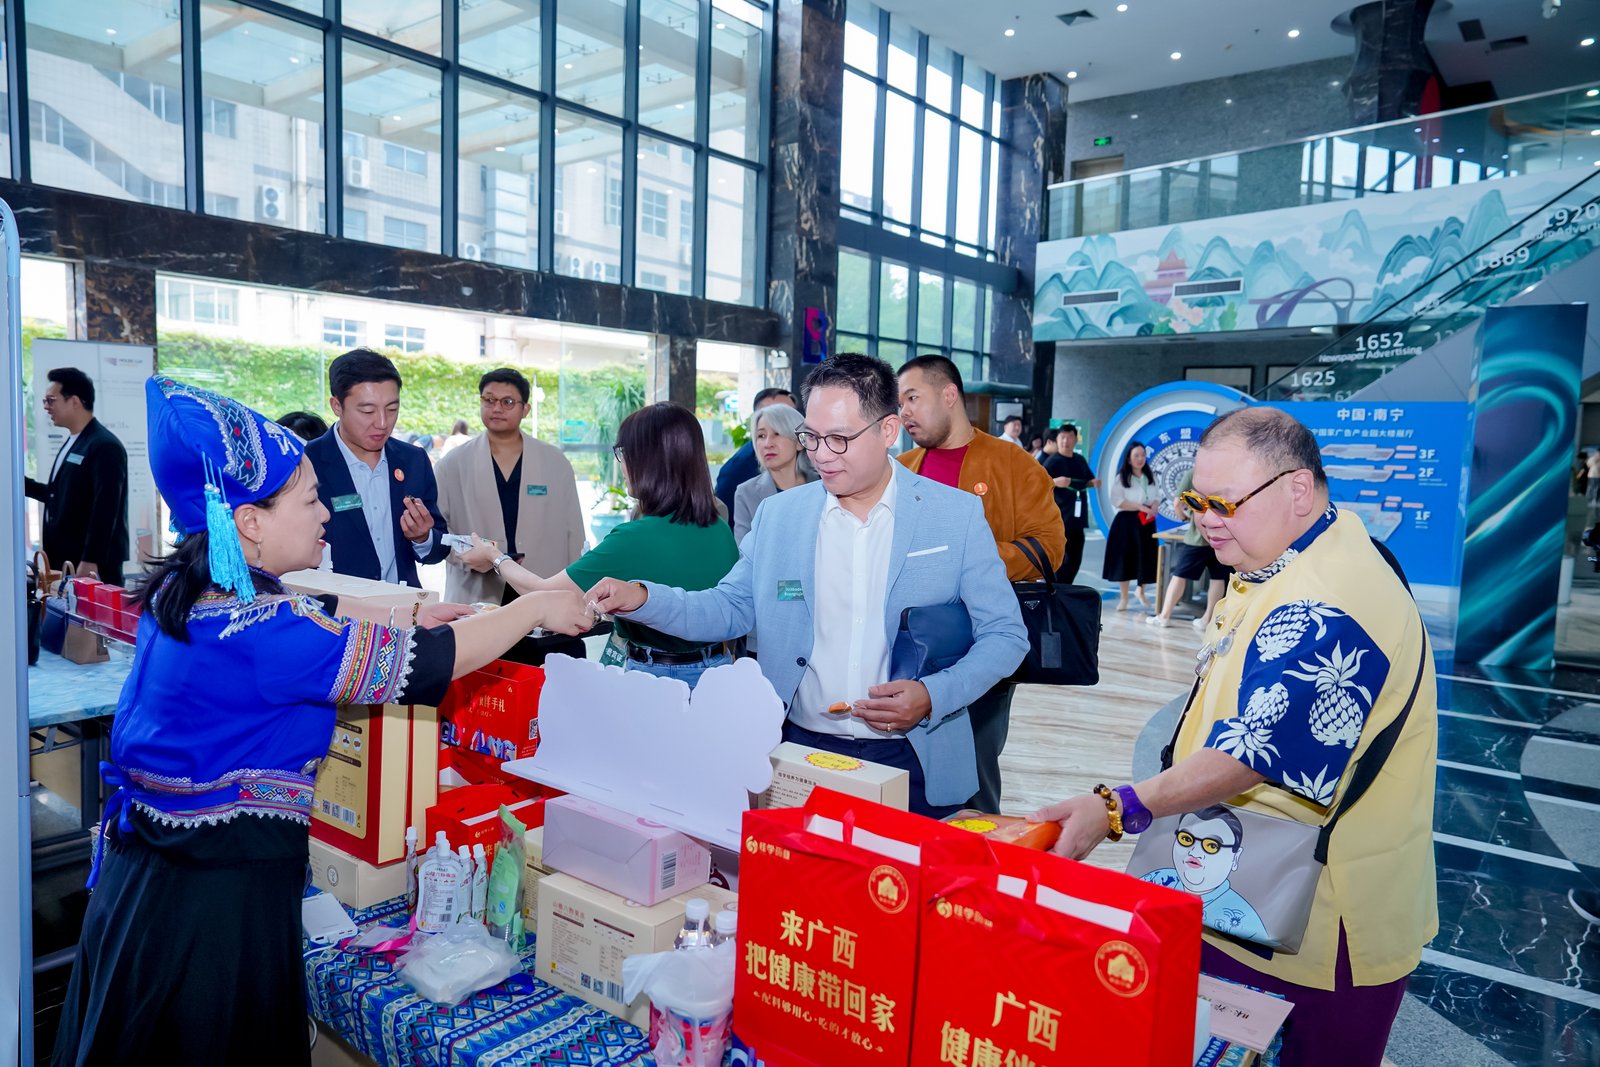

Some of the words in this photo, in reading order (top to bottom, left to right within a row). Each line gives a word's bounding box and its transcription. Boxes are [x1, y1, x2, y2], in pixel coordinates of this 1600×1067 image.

[1545, 202, 1600, 229] 1920
[1475, 246, 1530, 273] 1869
[1355, 331, 1405, 352] 1652
[1318, 351, 1365, 364] Newspaper
[1366, 345, 1423, 360] Advertising
[1290, 370, 1336, 388] 1625
[1336, 408, 1404, 422] 中国·南宁
[1418, 449, 1435, 460] 3F
[1418, 467, 1434, 478] 2F
[1415, 511, 1431, 521] 1F
[779, 909, 859, 970] 来广西
[744, 939, 897, 1034] 把健康带回家
[991, 990, 1063, 1052] 广西
